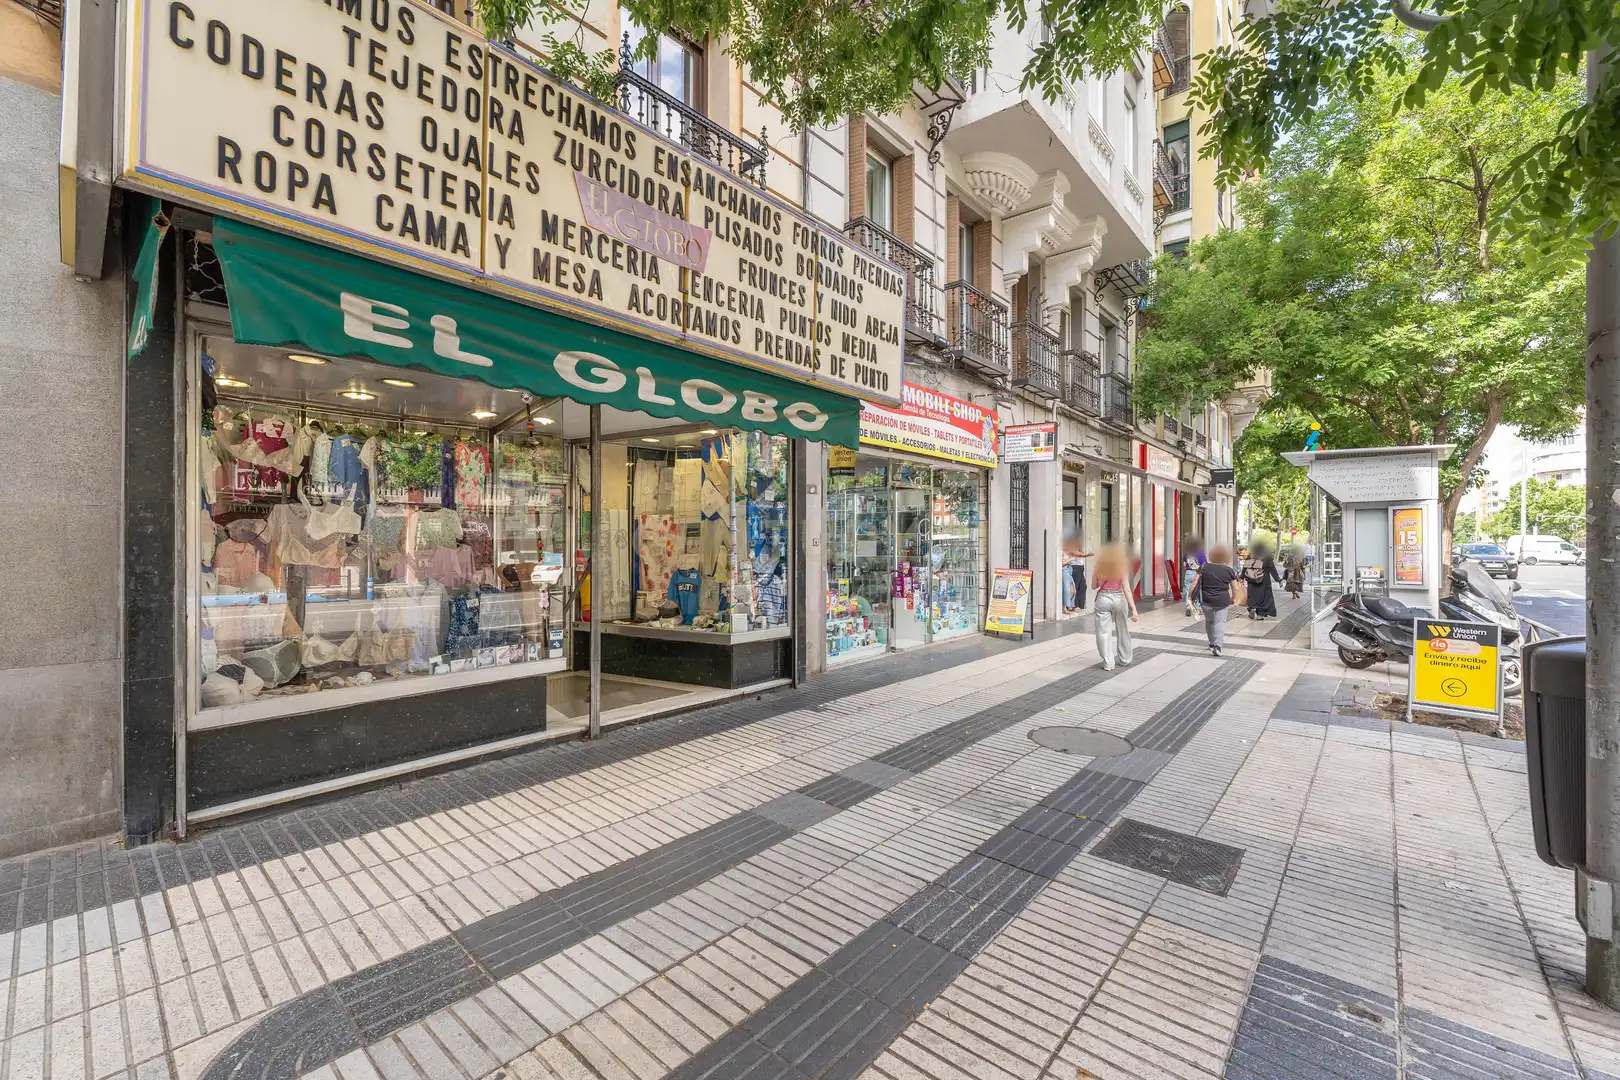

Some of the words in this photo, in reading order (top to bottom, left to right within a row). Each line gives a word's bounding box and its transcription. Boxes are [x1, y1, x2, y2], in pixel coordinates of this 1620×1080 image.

[168, 1, 384, 131] CODERAS
[421, 115, 540, 195] OJALES
[738, 257, 807, 308] FRUNCES
[815, 290, 825, 314] Y
[830, 298, 858, 328] NIDO
[865, 315, 900, 346] ABEJA
[341, 25, 525, 146] TEJEDORA
[553, 130, 684, 220] ZURCIDORA
[704, 205, 784, 267] PLISADOS
[796, 252, 864, 304] BORDADOS
[446, 31, 637, 161] ESTRECHAMOS
[654, 147, 782, 236] ENSANCHAMOS
[793, 221, 844, 268] FORROS
[853, 255, 904, 297] PRENDAS
[272, 104, 516, 230] CORSETERIA
[541, 209, 661, 285] MERCERIA
[679, 265, 766, 324] LENCERIA
[780, 306, 832, 347] PUNTOS
[841, 331, 878, 364] MEDIA
[614, 204, 703, 266] GLOBO
[216, 135, 338, 216] ROPA
[375, 193, 471, 259] CAMA
[494, 232, 512, 270] Y
[532, 247, 604, 301] MESA
[628, 283, 741, 345] ACORTAMOS
[754, 327, 821, 370] PRENDAS
[830, 354, 846, 379] DE
[854, 362, 889, 392] PUNTO
[340, 291, 494, 368] EL
[553, 350, 829, 432] GLOBO
[903, 384, 951, 415] MOBILE
[953, 401, 983, 424] SHOP
[859, 410, 899, 428] REPARACIÓN
[899, 420, 907, 431] DE
[934, 428, 954, 442] TABLETS
[954, 434, 959, 443] Y
[859, 427, 869, 438] DE
[869, 429, 898, 444] MÓVILES
[901, 437, 936, 452] ACCESORIOS
[939, 445, 961, 457] MALETAS
[960, 450, 965, 458] Y
[1398, 530, 1418, 546] 15
[1430, 640, 1446, 648] ria
[1452, 626, 1487, 636] Western
[1430, 660, 1459, 668] dinero
[1456, 656, 1488, 664] recibe
